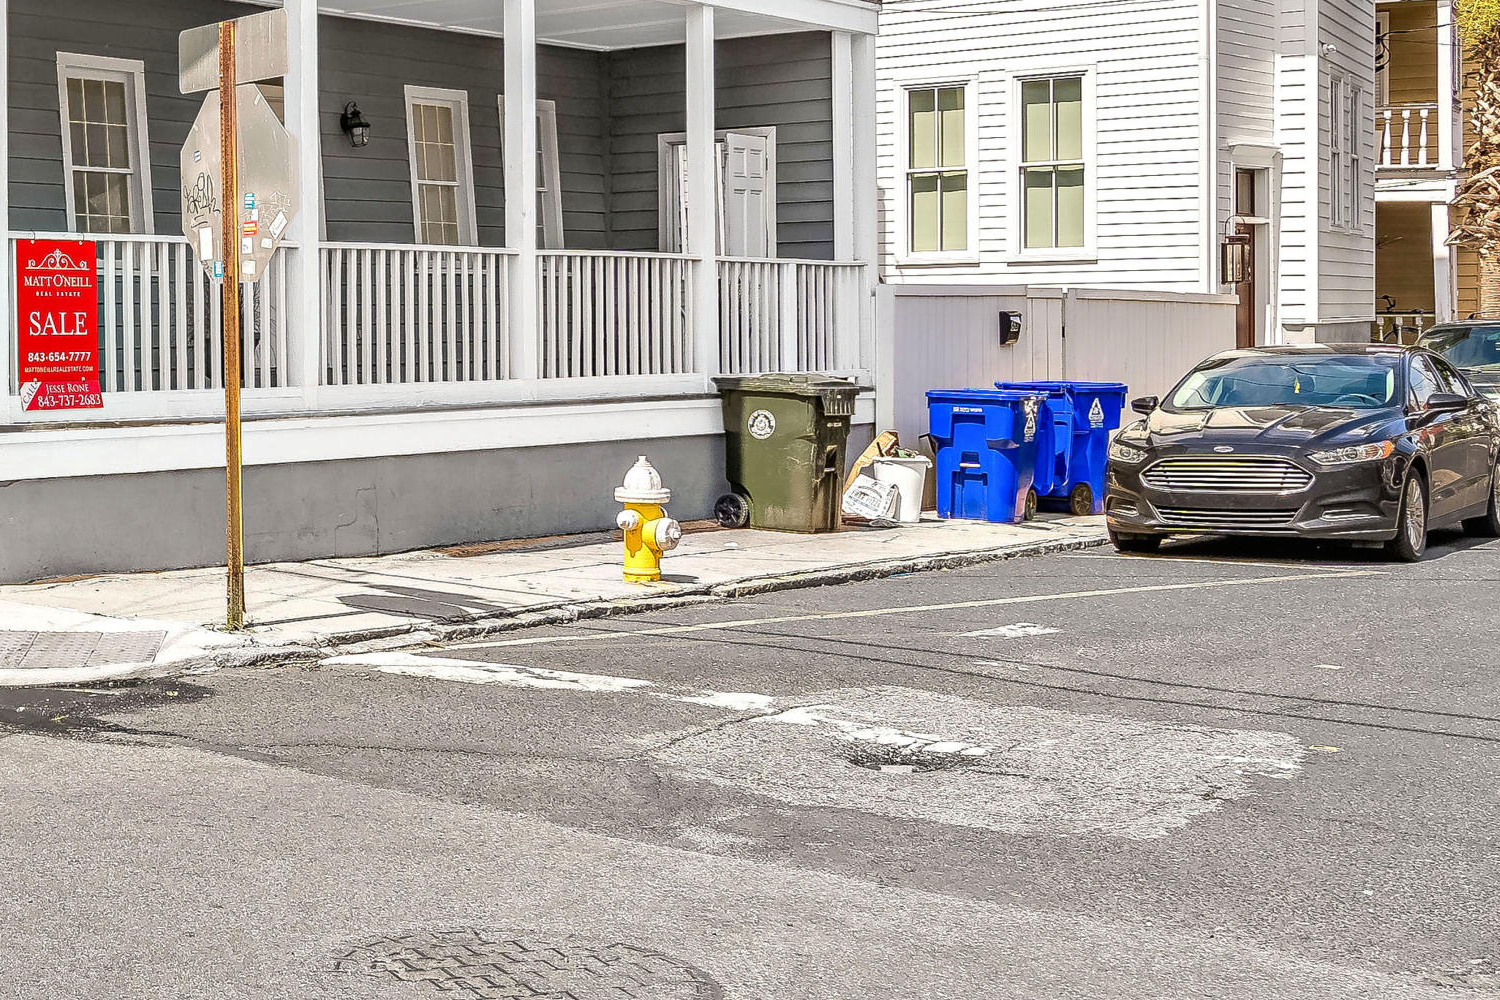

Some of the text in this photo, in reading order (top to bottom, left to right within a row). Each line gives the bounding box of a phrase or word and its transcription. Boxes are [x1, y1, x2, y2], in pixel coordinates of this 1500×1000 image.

[24, 274, 92, 287] MATT O'NEILL
[29, 311, 88, 336] SALE
[22, 382, 38, 404] CALL
[45, 383, 89, 394] JESSE RONE
[38, 393, 101, 407] 843-737-2683
